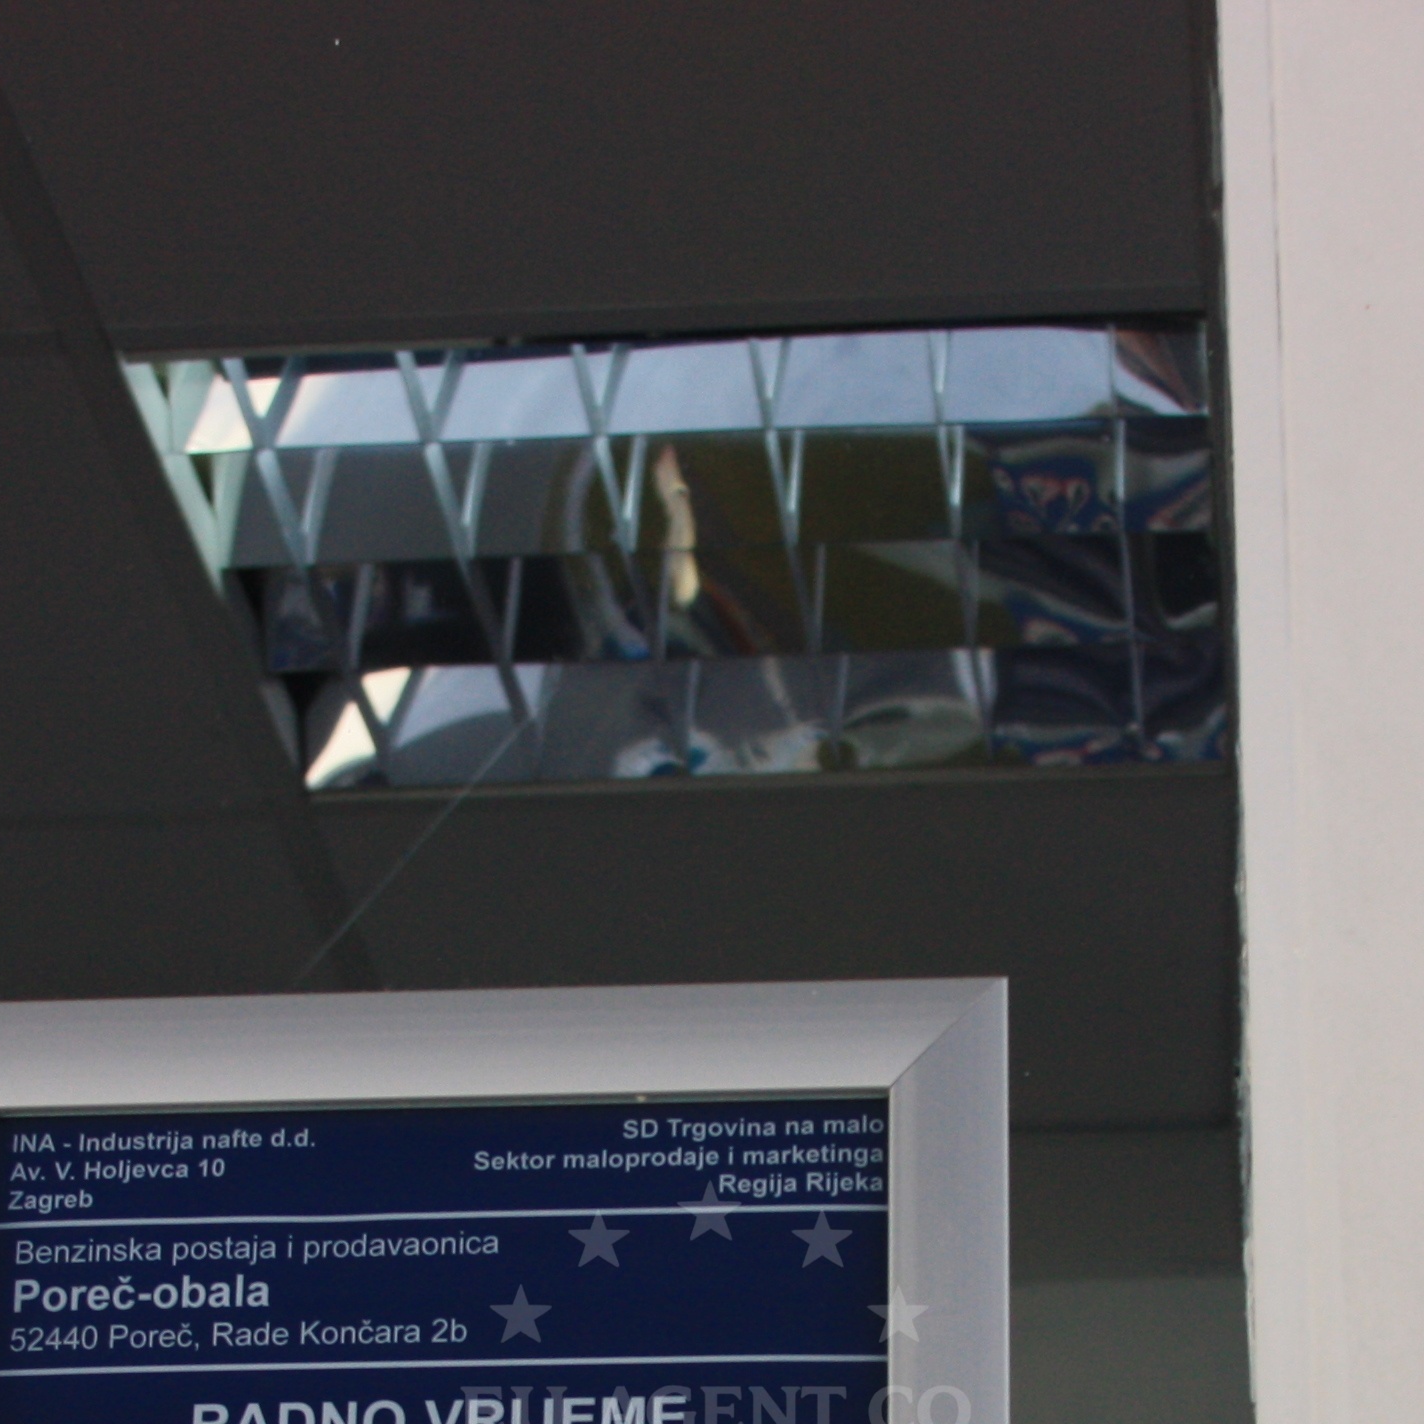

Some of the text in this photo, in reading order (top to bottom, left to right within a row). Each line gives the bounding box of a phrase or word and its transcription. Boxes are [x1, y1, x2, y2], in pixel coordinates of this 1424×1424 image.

[13, 1133, 55, 1152] INA
[79, 1131, 193, 1157] Industrija
[202, 1129, 262, 1148] nafte
[271, 1128, 315, 1147] d.d.
[623, 1114, 884, 1142] SD Trgovina na malo
[10, 1158, 225, 1183] Av. V. Holjevca 10
[474, 1143, 884, 1173] Sektor maloprodaje i marketinga
[719, 1172, 884, 1198] Regija Rijeka
[8, 1189, 93, 1215] Zagreb
[16, 1231, 498, 1266] Benzinska postaja i prodavaonica
[14, 1273, 269, 1312] Poreč-obala
[11, 1318, 467, 1351] 52440 Poreč, Rade Končara 2b
